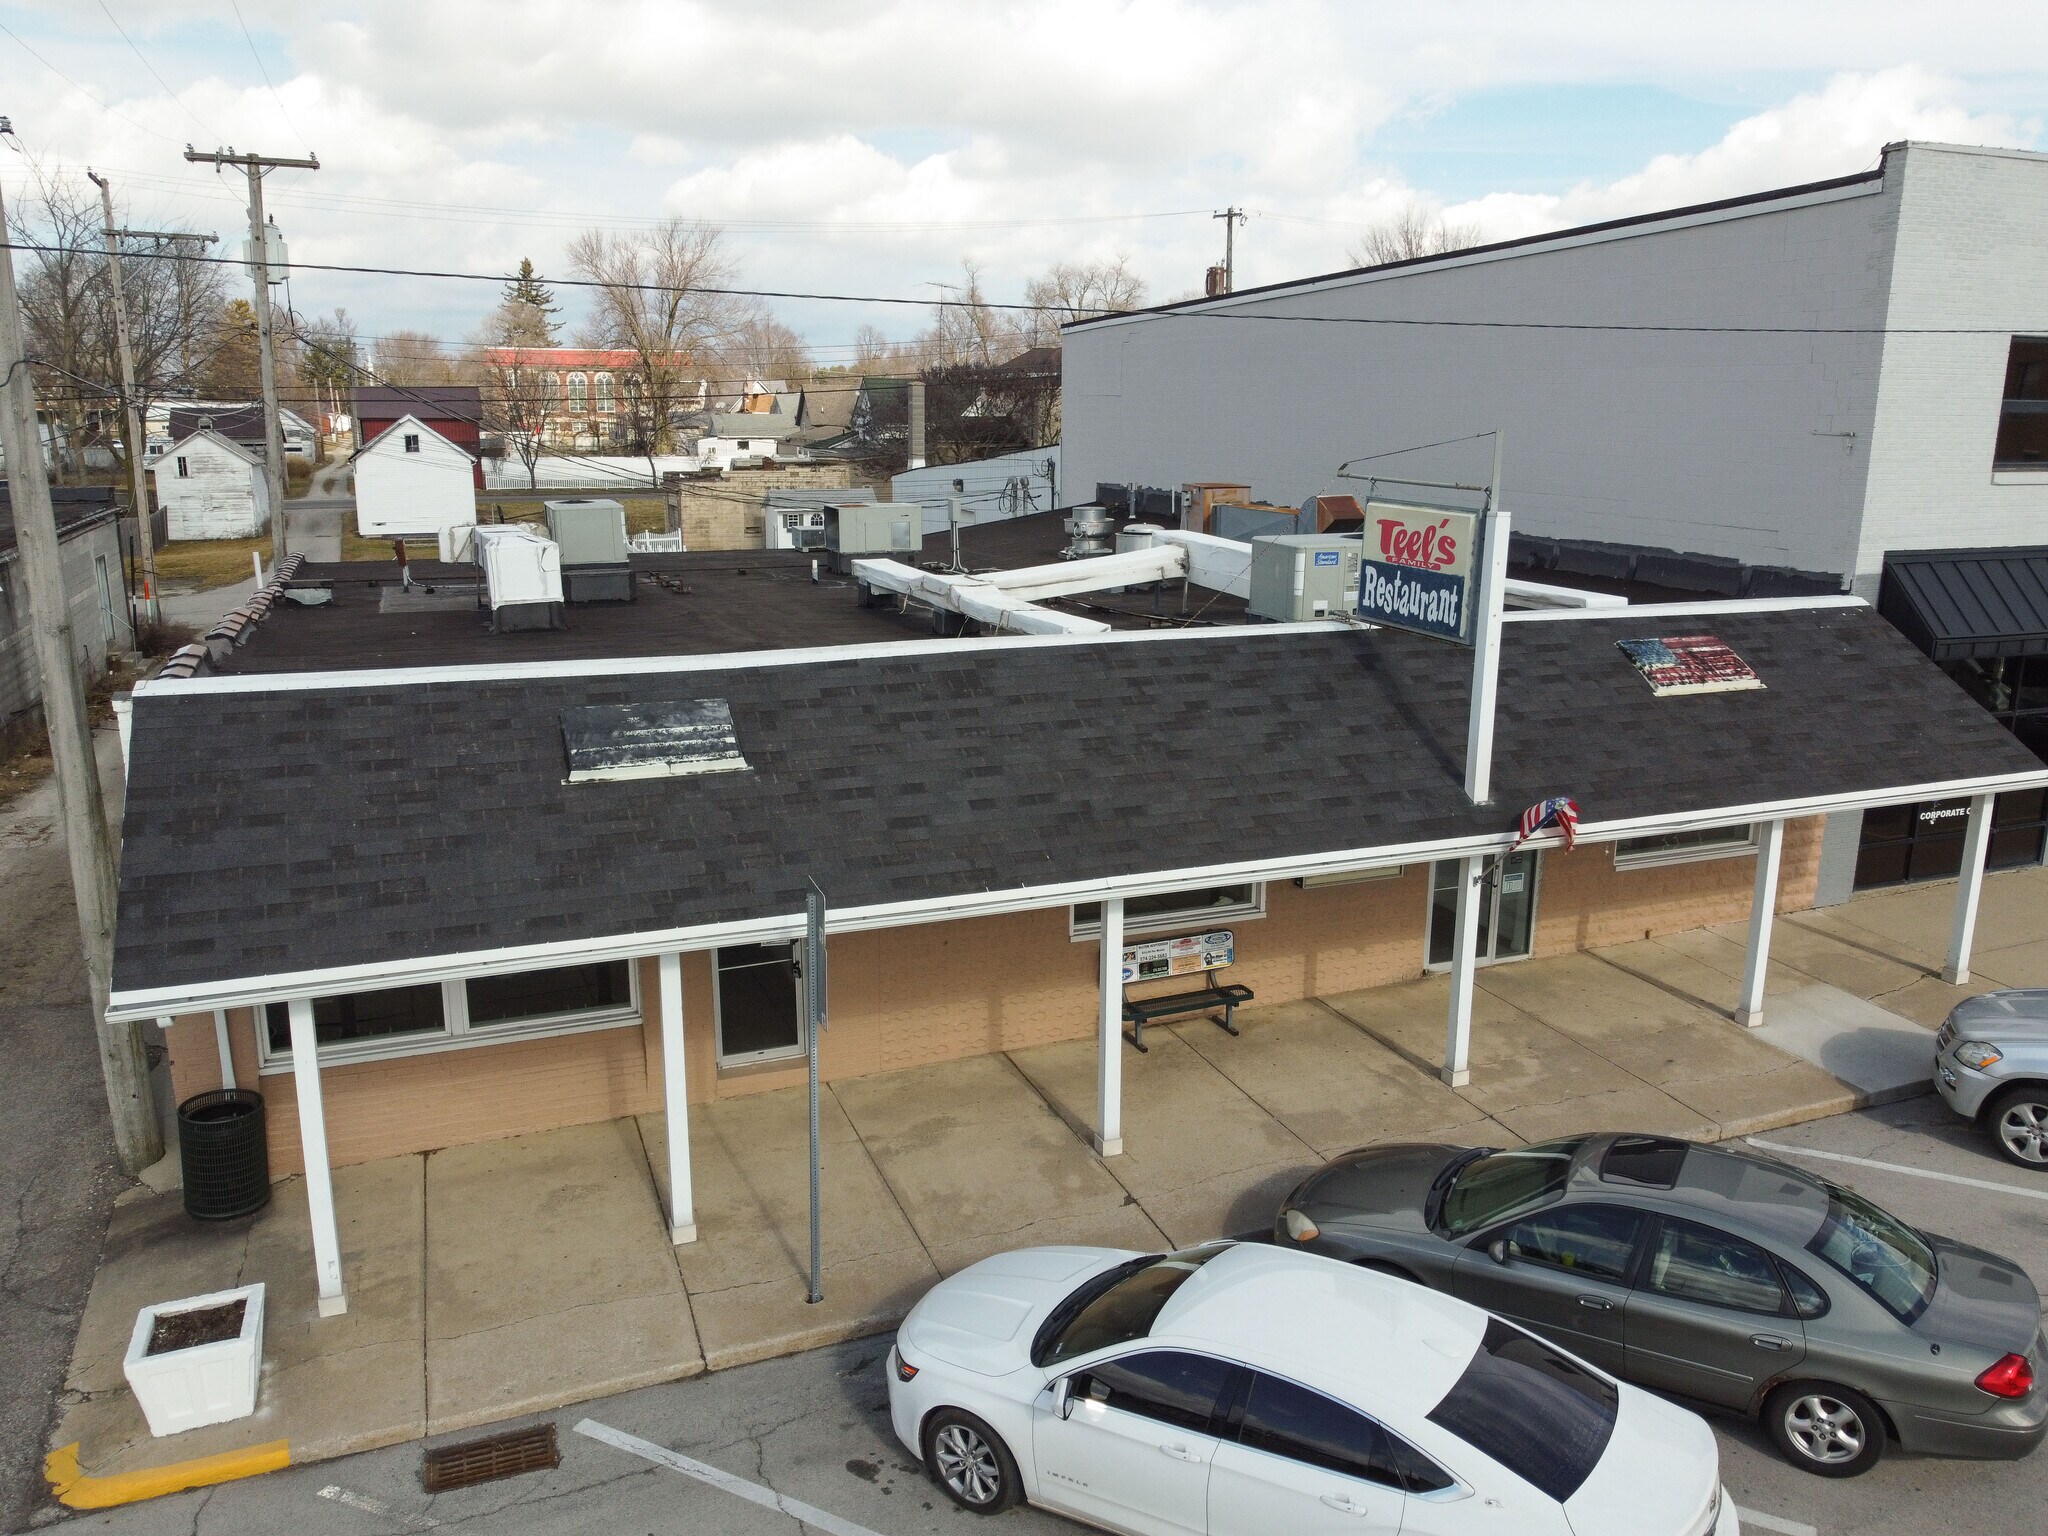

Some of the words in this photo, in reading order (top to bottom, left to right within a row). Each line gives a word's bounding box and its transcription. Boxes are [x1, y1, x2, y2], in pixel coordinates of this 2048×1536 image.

[1376, 518, 1457, 566] Teel's
[1391, 557, 1434, 569] FAMILY
[1362, 565, 1458, 628] Restaurant
[1920, 808, 1965, 820] CORPORATE
[1046, 1470, 1088, 1487] IMPALA
